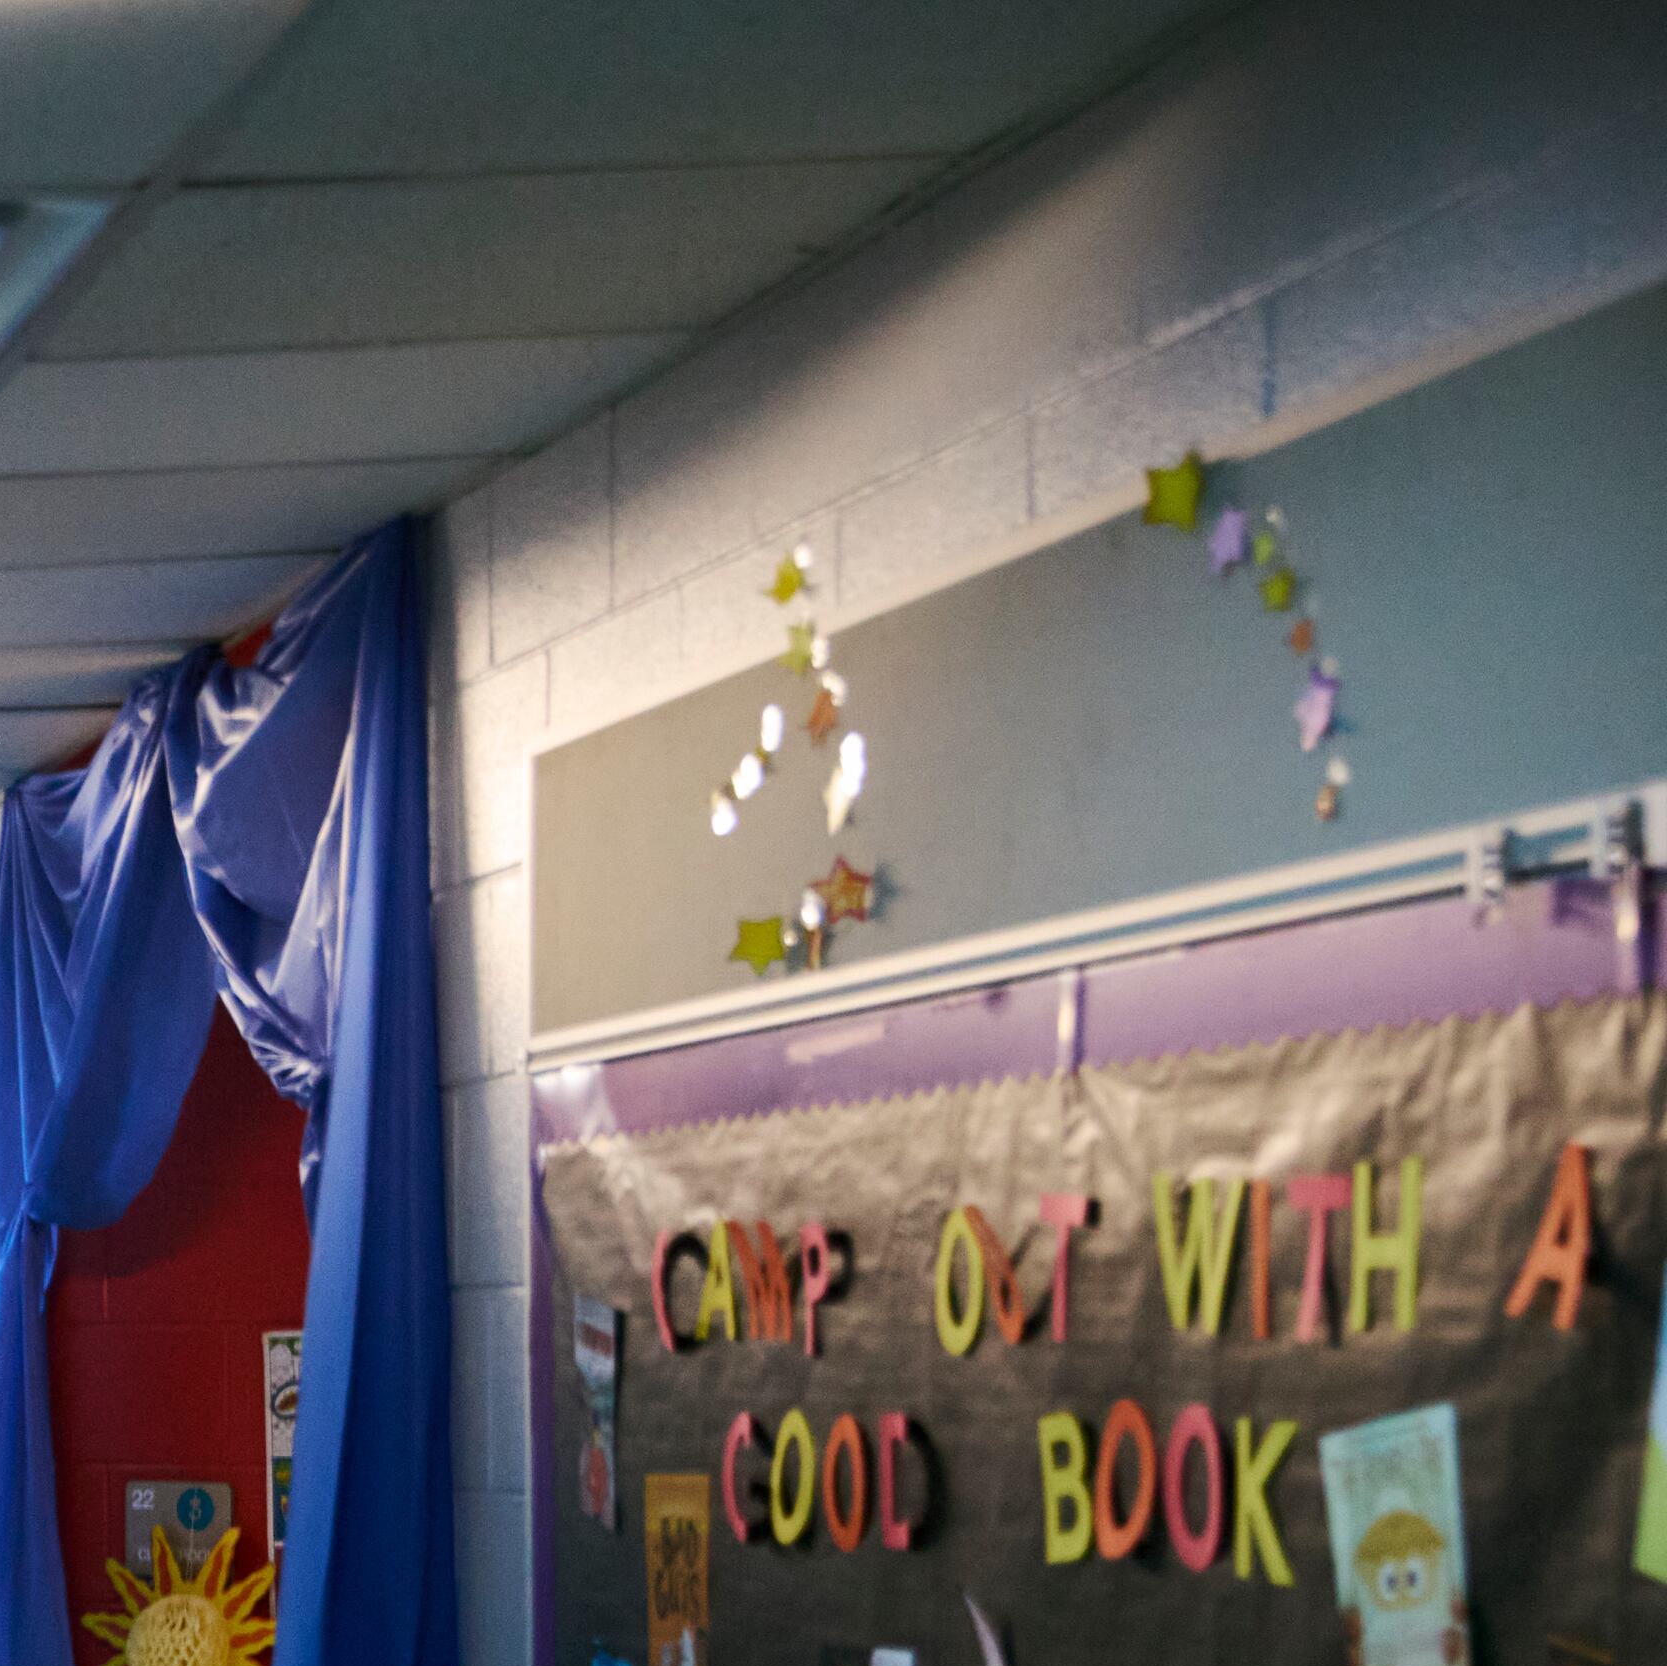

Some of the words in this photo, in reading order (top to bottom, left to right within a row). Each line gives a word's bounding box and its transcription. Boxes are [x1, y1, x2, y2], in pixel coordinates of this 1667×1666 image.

[651, 1219, 830, 1356] CAMP
[934, 1193, 1087, 1357] OUT
[1153, 1155, 1424, 1343] WITH
[1503, 1143, 1590, 1332] A
[132, 1488, 155, 1511] 22
[1037, 1399, 1298, 1586] BOOK
